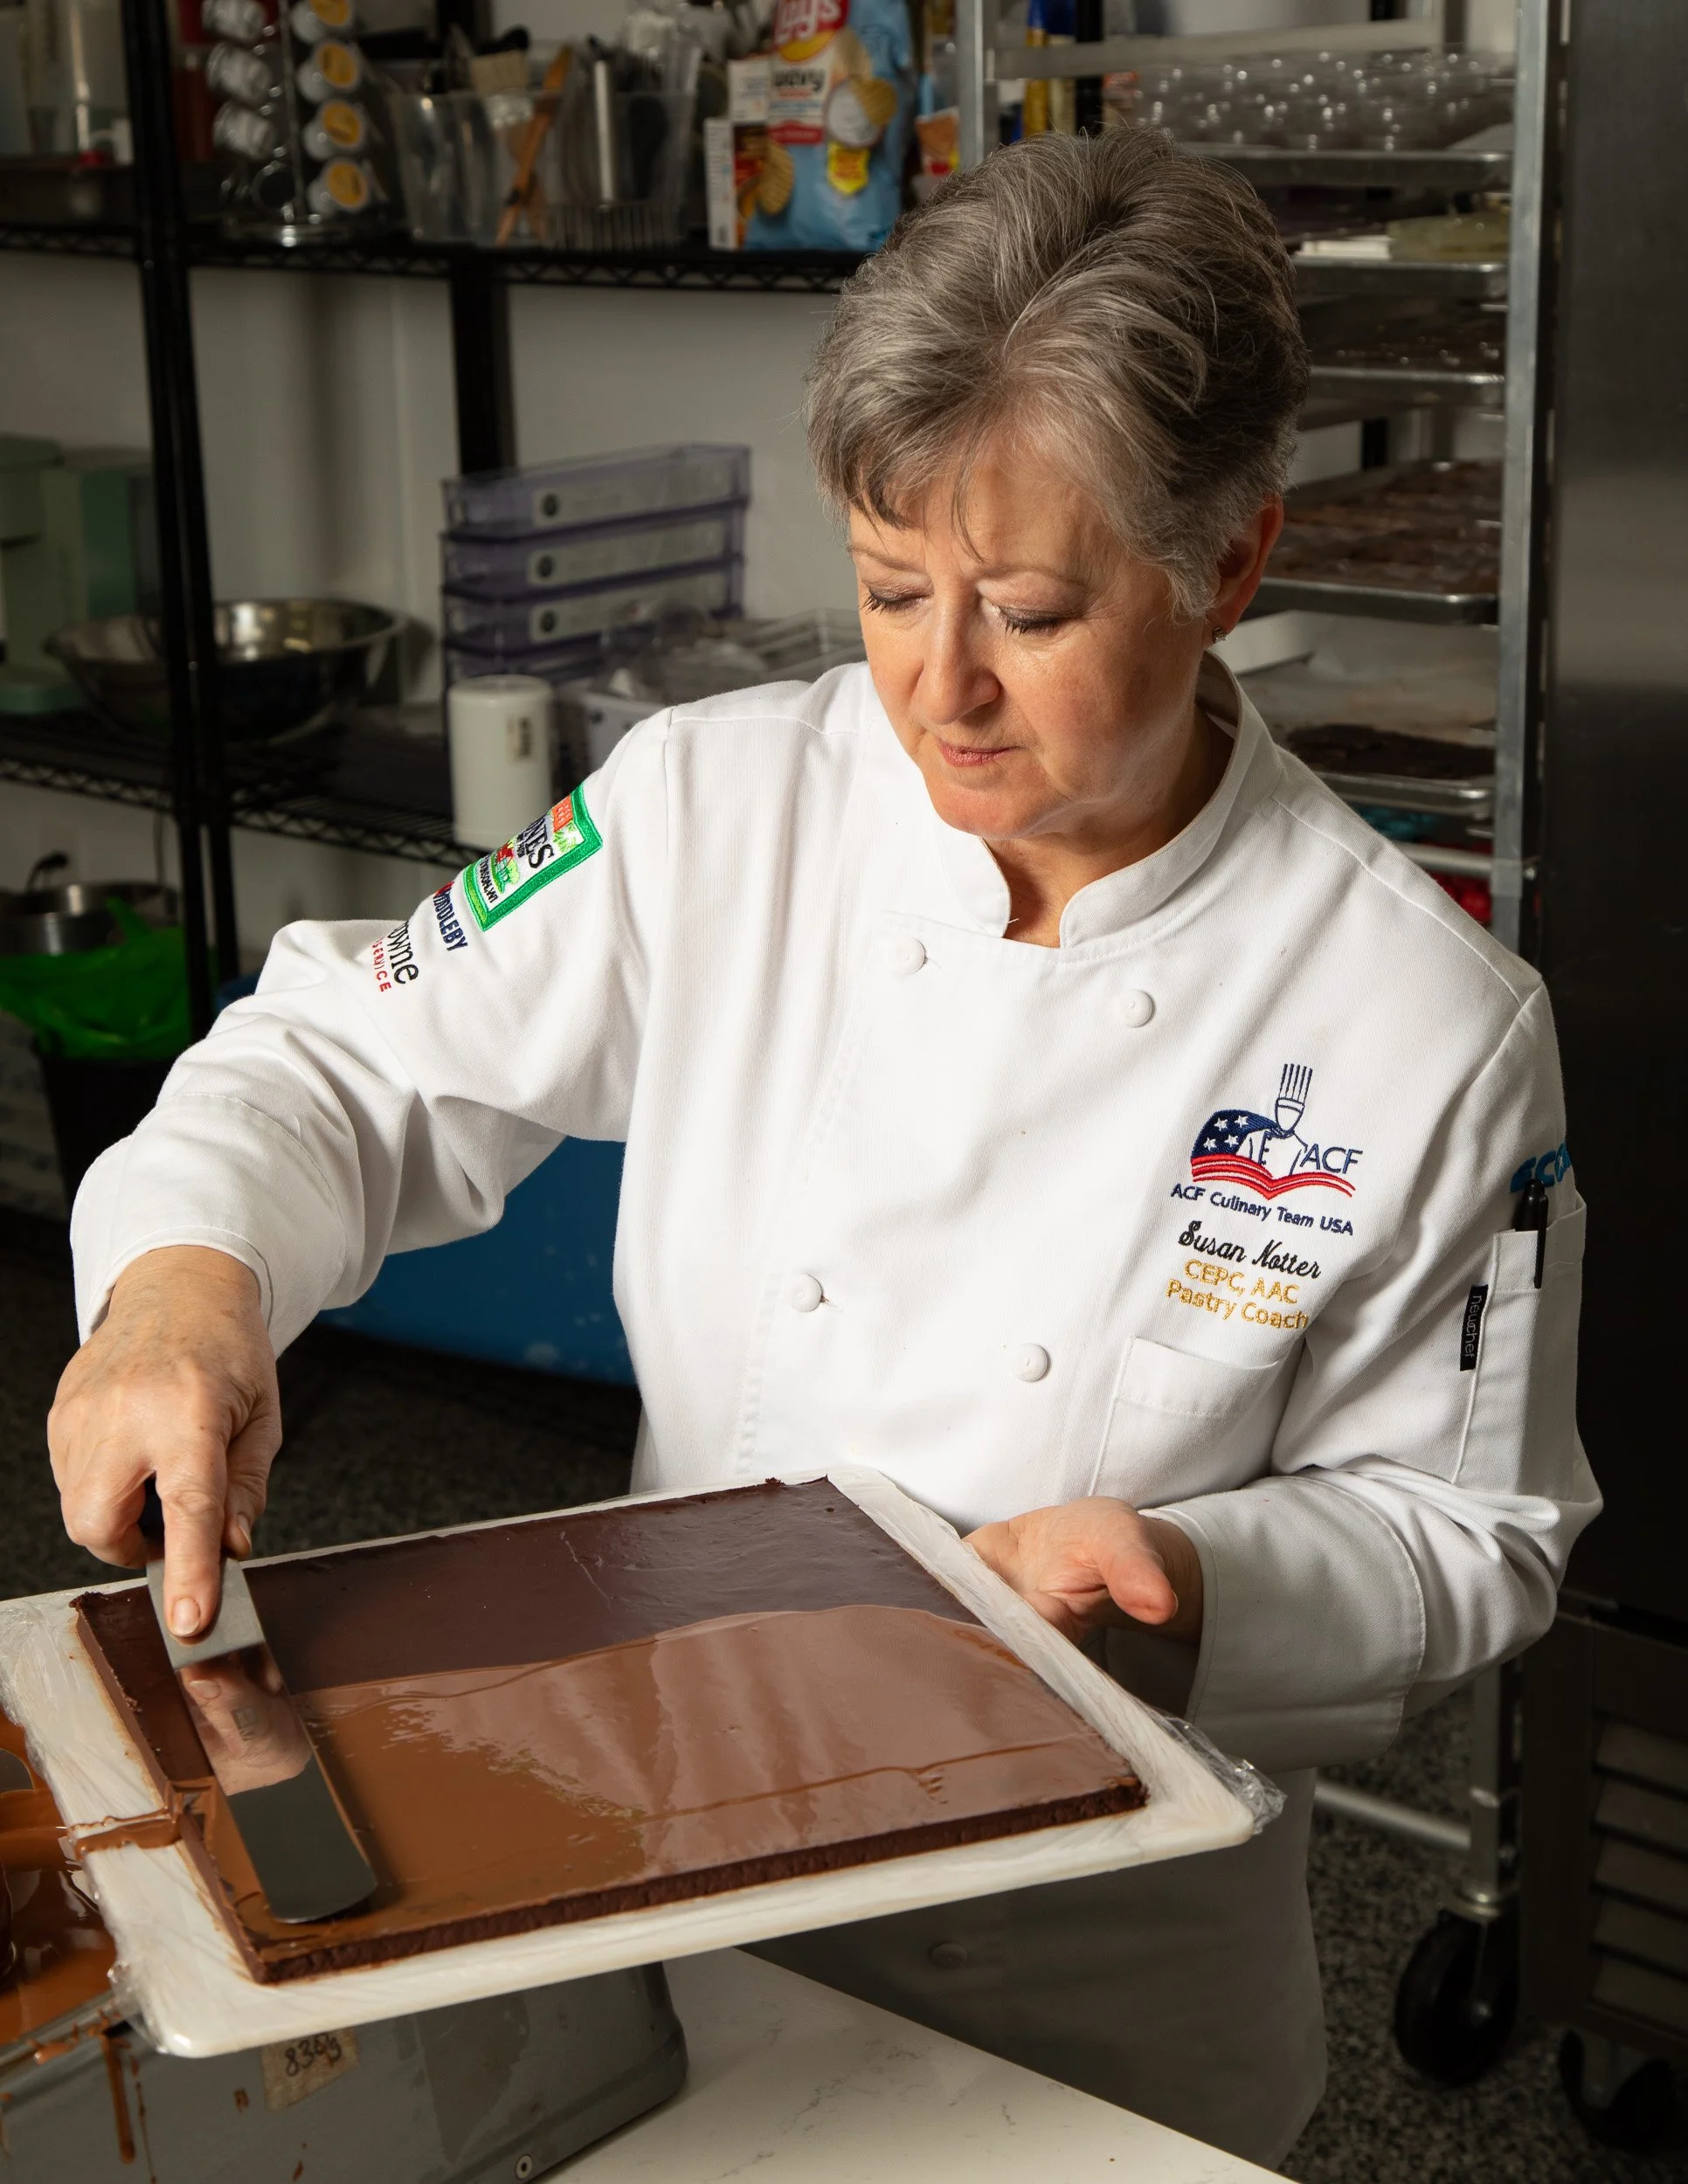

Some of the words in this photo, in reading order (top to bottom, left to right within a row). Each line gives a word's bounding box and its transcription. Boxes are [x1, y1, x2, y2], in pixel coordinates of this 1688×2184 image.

[1300, 1143, 1363, 1174] ACF
[1171, 1183, 1207, 1201] ACF
[1210, 1192, 1272, 1221] Culinary
[1277, 1206, 1314, 1228] Team
[1320, 1216, 1353, 1236] USA
[1178, 1220, 1247, 1262] Susan
[1252, 1239, 1321, 1280] Notter
[1166, 1278, 1237, 1321] Pastry
[1241, 1301, 1309, 1330] Coach
[1185, 1259, 1245, 1296] CEPC,
[1250, 1276, 1300, 1304] AAC
